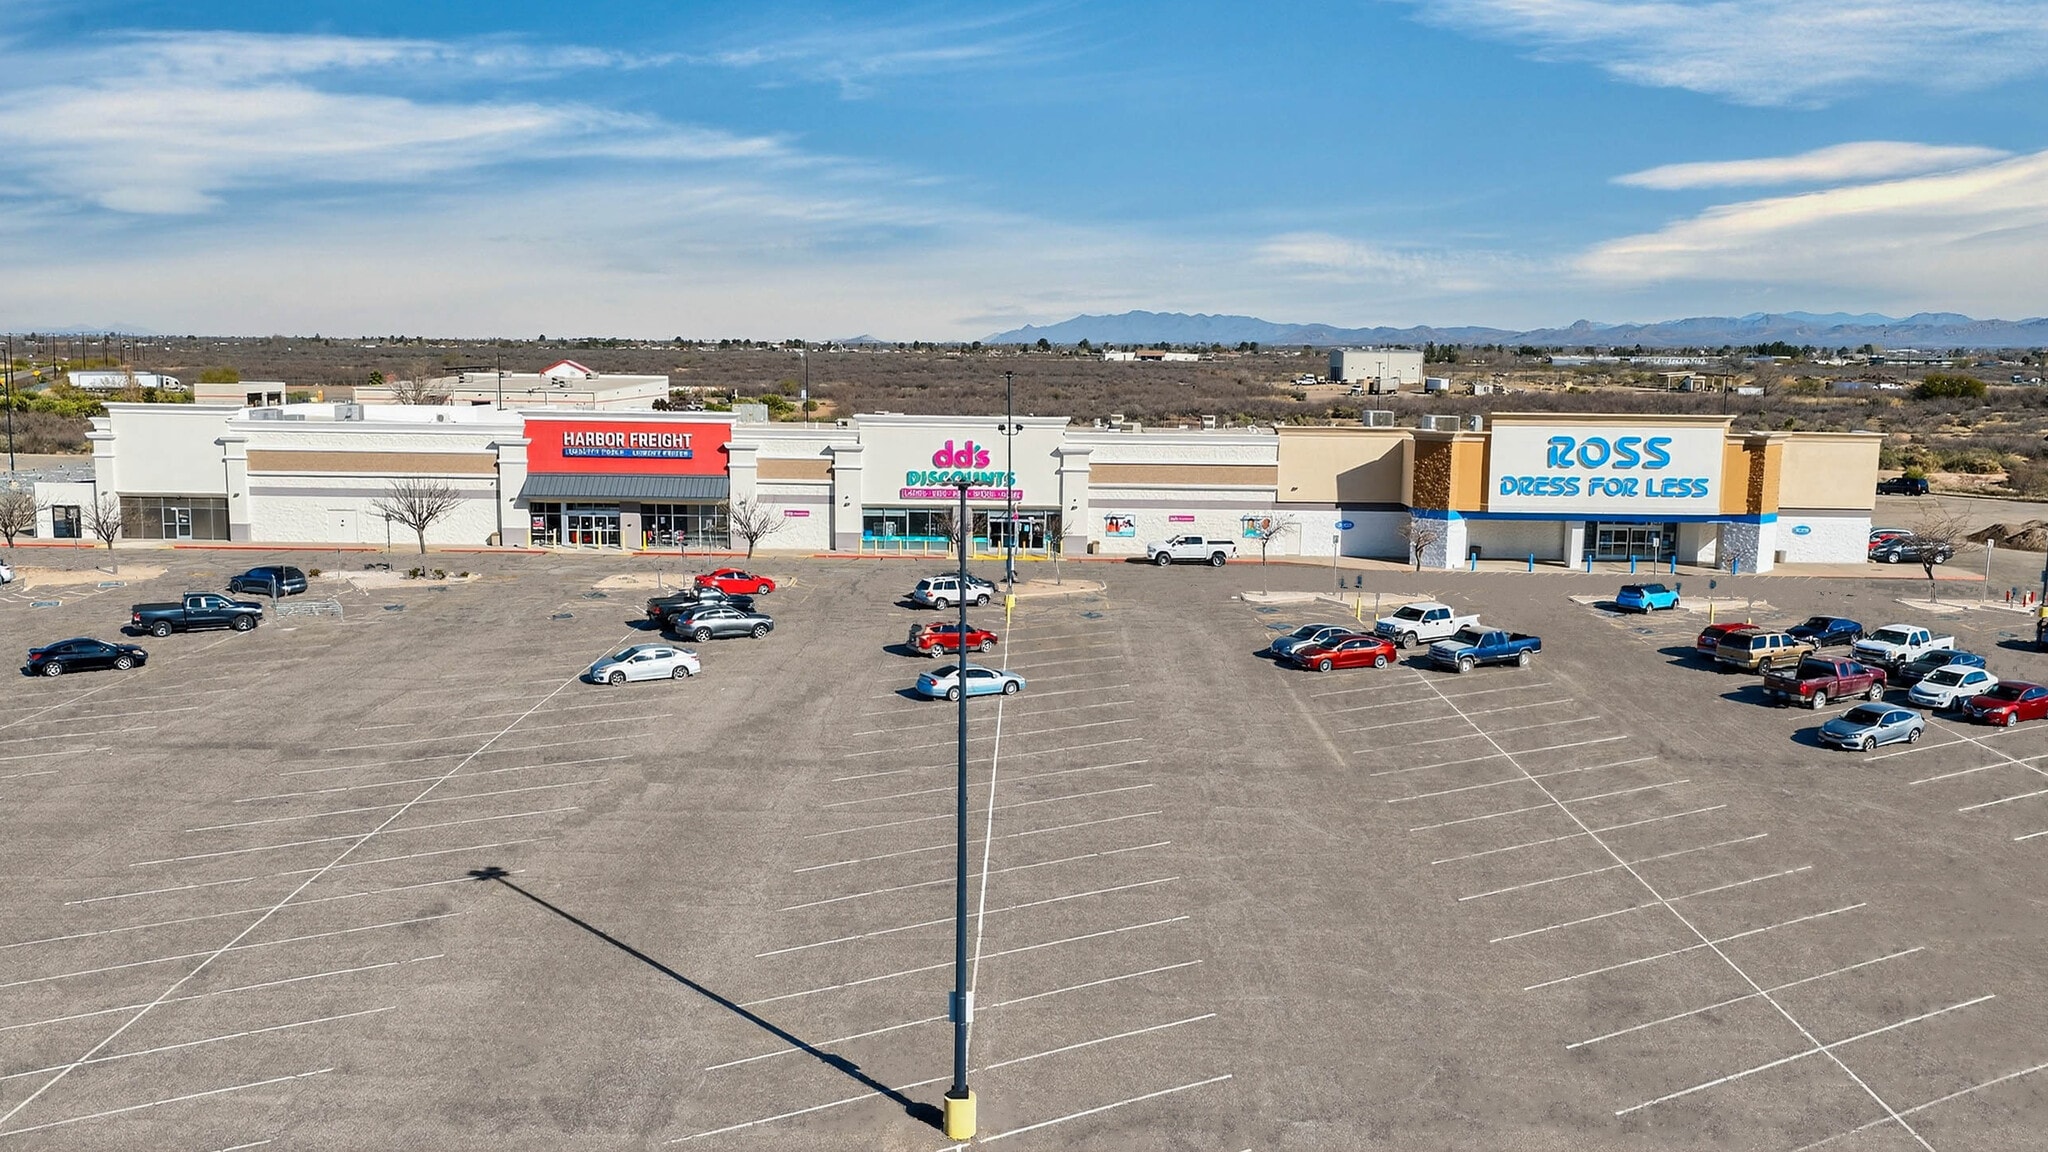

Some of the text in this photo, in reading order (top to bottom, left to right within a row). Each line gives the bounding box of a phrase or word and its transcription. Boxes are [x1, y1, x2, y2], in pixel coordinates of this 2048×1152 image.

[563, 431, 692, 448] HARBOR FREIGHT
[932, 439, 991, 469] dd's
[1547, 436, 1672, 469] ROSS
[906, 470, 1016, 487] DISCOUNTS
[1500, 476, 1709, 498] DRESS FOR LESS
